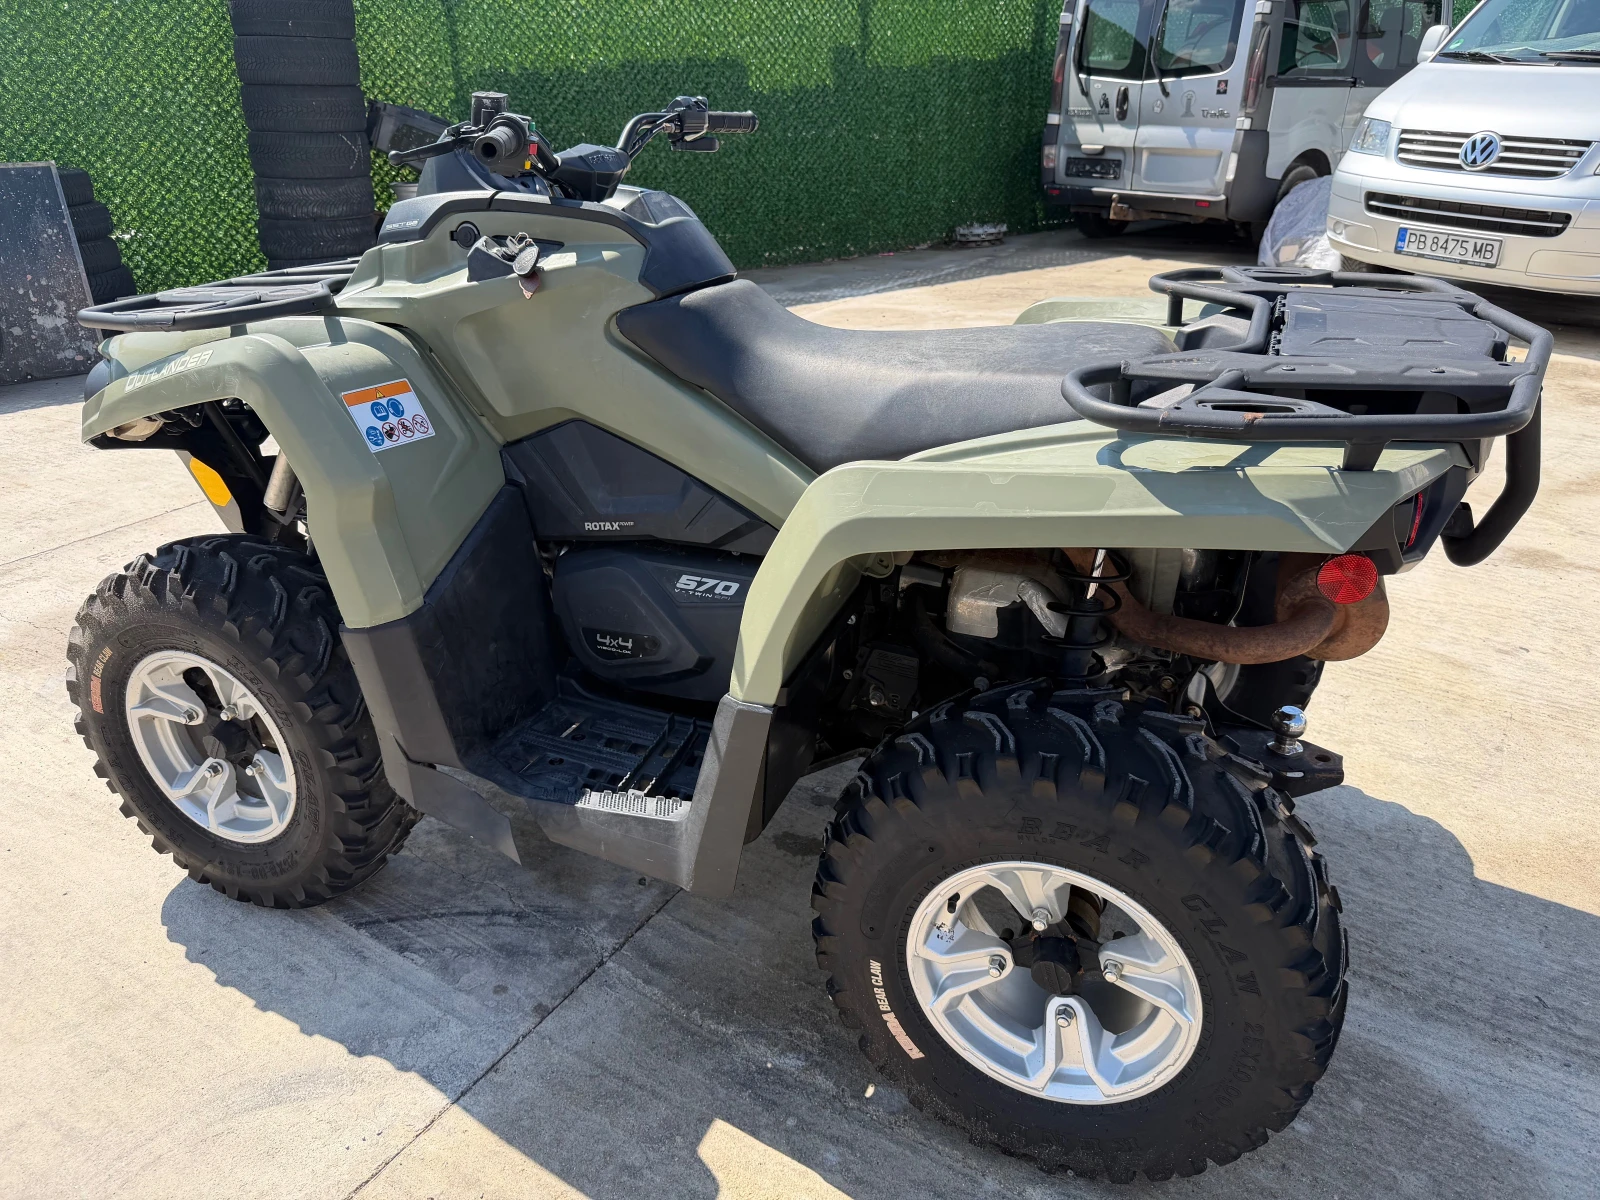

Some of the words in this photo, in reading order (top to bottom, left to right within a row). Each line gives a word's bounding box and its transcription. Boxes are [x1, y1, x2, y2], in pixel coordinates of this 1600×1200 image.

[1407, 232, 1427, 250] PB
[1430, 235, 1469, 256] 8475
[1472, 241, 1495, 260] MB
[125, 349, 214, 393] OUTLANDER
[584, 521, 620, 531] ROTAX
[676, 575, 740, 596] 570
[93, 660, 105, 678] BEAR
[99, 646, 113, 663] CLAW
[1017, 816, 1150, 872] BEAR
[1180, 893, 1262, 998] CLAW
[869, 959, 884, 986] CLAW
[873, 987, 892, 1012] BEAR
